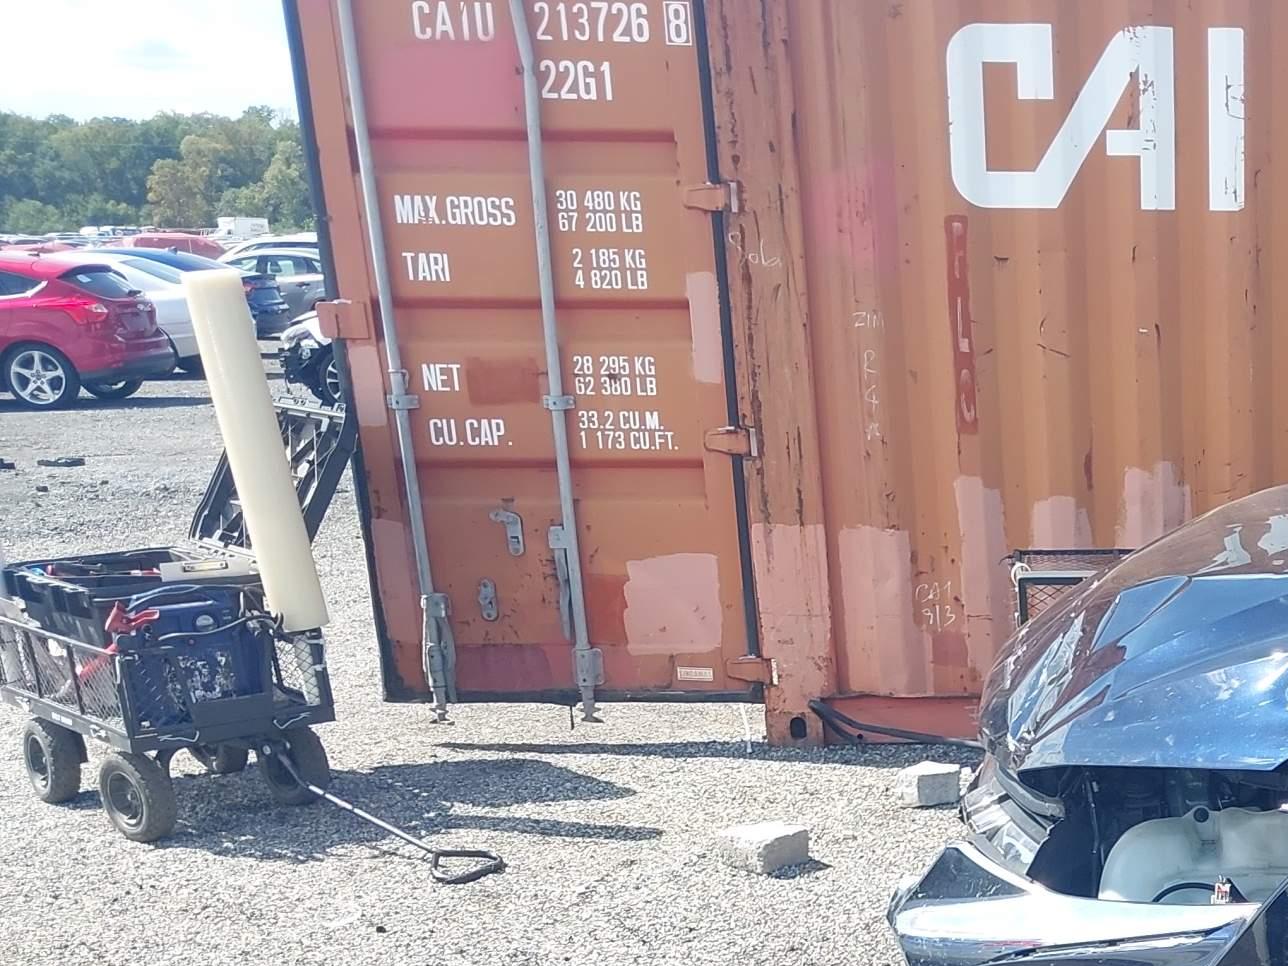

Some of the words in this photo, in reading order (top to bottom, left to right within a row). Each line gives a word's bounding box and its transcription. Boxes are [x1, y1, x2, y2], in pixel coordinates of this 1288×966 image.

[534, 1, 650, 42] 213726
[668, 3, 687, 43] 8
[539, 59, 613, 100] 22G1
[946, 23, 1245, 211] CAI
[394, 195, 516, 226] MAX.GROSS
[556, 190, 577, 210] 30
[583, 191, 614, 211] 480
[620, 191, 641, 211] KG
[558, 212, 578, 232] 67
[586, 213, 616, 232] 200
[622, 213, 643, 232] LB
[401, 252, 450, 281] TARI
[572, 248, 583, 268] 2
[590, 249, 620, 269] 185
[624, 249, 647, 269] KG
[575, 270, 584, 288] 4
[590, 270, 622, 289] 820
[627, 271, 648, 289] LB
[573, 356, 593, 374] 28
[600, 356, 629, 375] 295
[635, 357, 655, 375] KG
[421, 363, 460, 392] NET
[575, 377, 596, 395] 62
[601, 377, 630, 395] 380
[636, 378, 657, 395] LB
[578, 411, 614, 429] 33.2
[619, 411, 664, 429] CU.M.
[580, 432, 587, 448] 1
[596, 432, 625, 449] 173
[630, 432, 679, 450] CU.FT.
